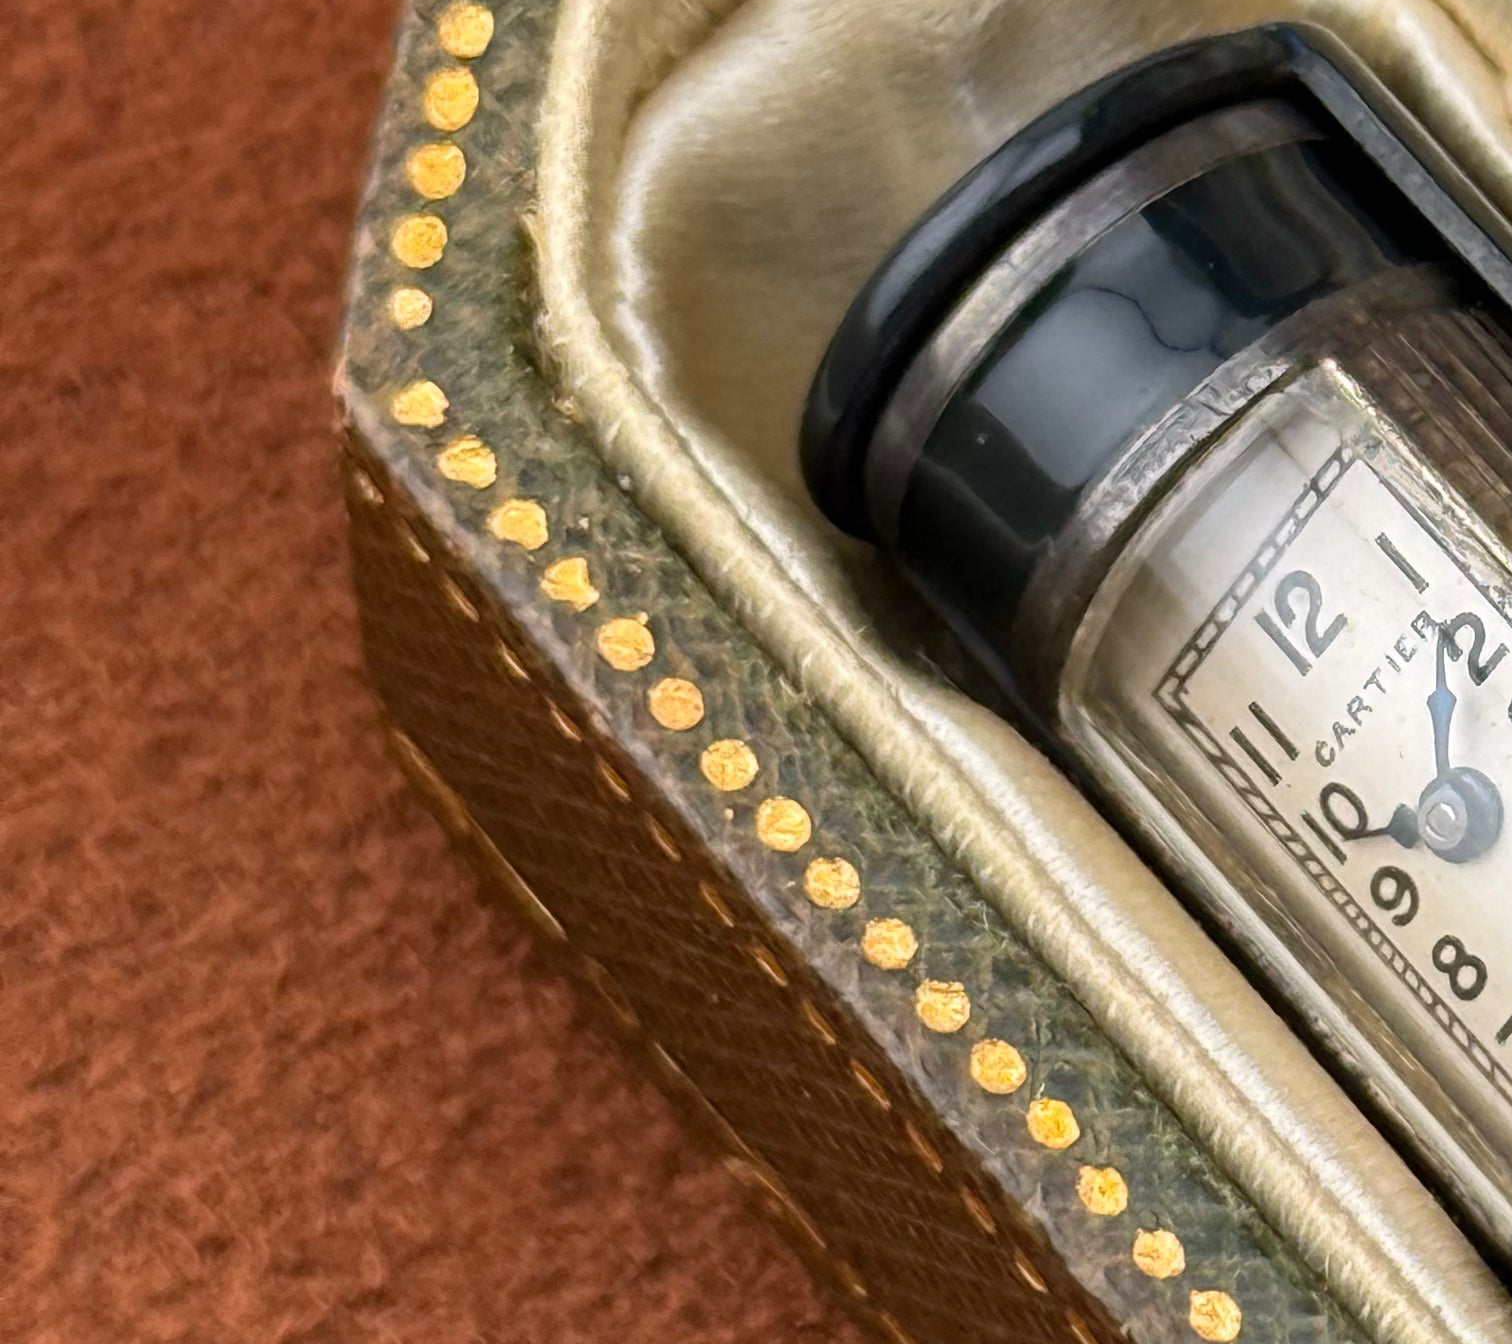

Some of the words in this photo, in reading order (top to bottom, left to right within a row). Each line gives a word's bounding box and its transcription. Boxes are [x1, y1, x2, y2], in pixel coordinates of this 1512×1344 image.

[1375, 532, 1429, 594] 1
[1254, 570, 1348, 676] 12
[1445, 612, 1510, 686] 2
[1314, 610, 1449, 767] CARTIER
[1229, 701, 1300, 787] 11
[1300, 782, 1368, 866] 10
[1370, 866, 1420, 926] 9
[1432, 934, 1488, 1002] 8
